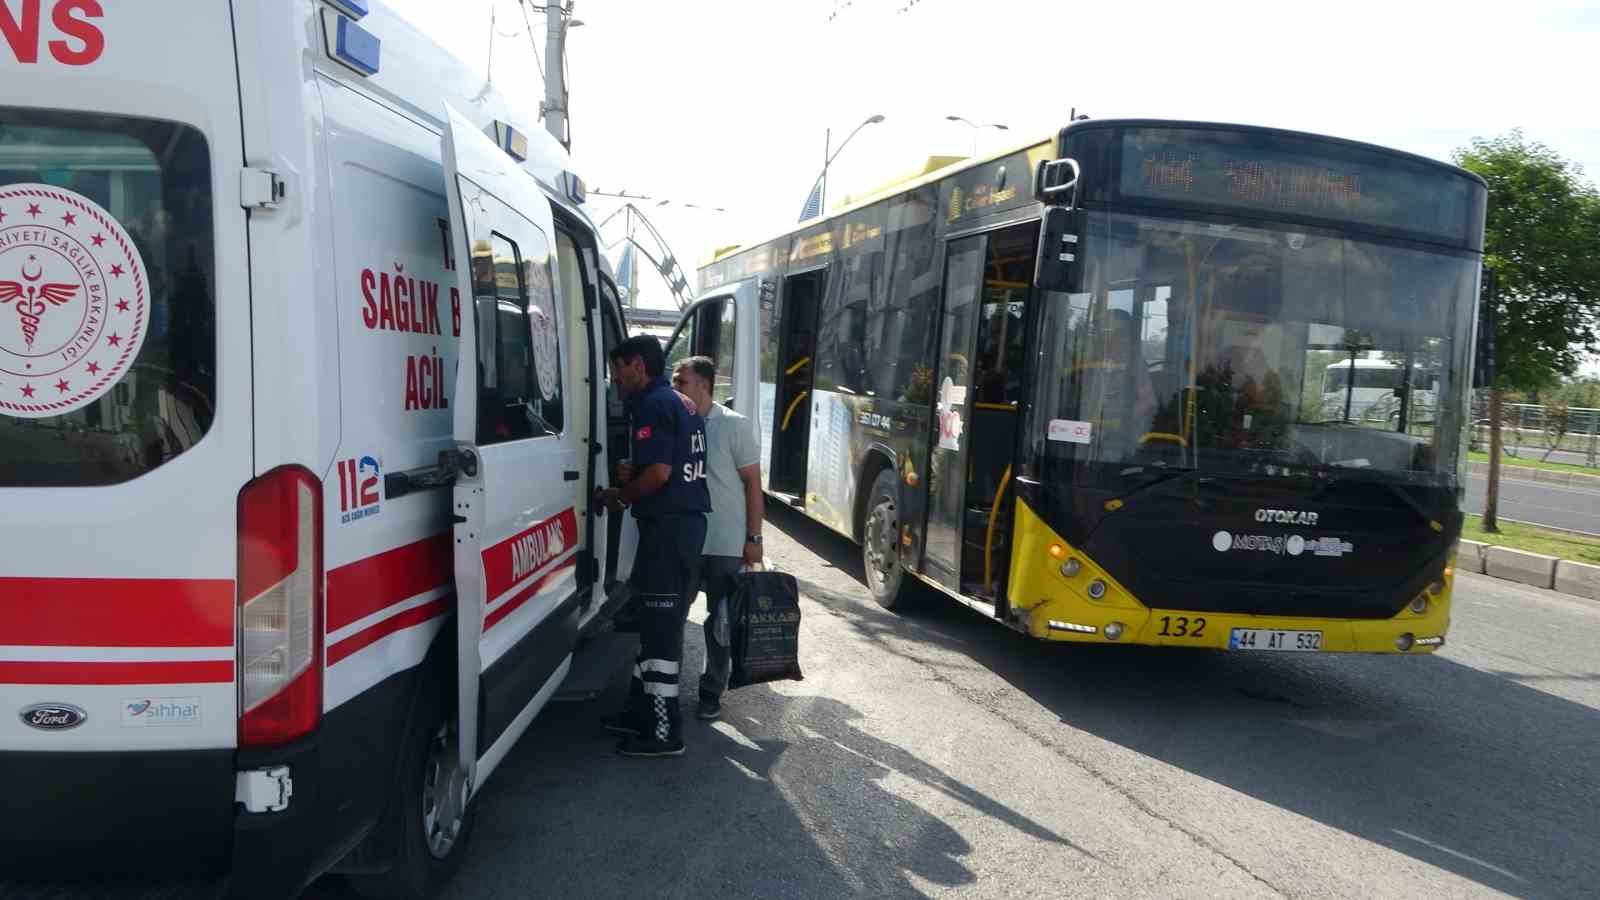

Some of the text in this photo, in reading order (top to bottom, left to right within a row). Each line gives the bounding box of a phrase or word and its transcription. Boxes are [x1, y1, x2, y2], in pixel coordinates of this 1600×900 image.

[0, 0, 105, 65] NS
[51, 236, 97, 280] SAĞLIK
[61, 284, 102, 361] BAKANLIĞI
[360, 262, 442, 336] SAĞLIK
[404, 346, 449, 411] ACİL
[337, 455, 380, 513] 112
[1254, 509, 1319, 525] OTOKAR
[511, 518, 565, 582] AMBULANS
[1157, 615, 1207, 638] 132
[1240, 631, 1321, 649] 44 AT 532
[31, 709, 71, 725] Ford
